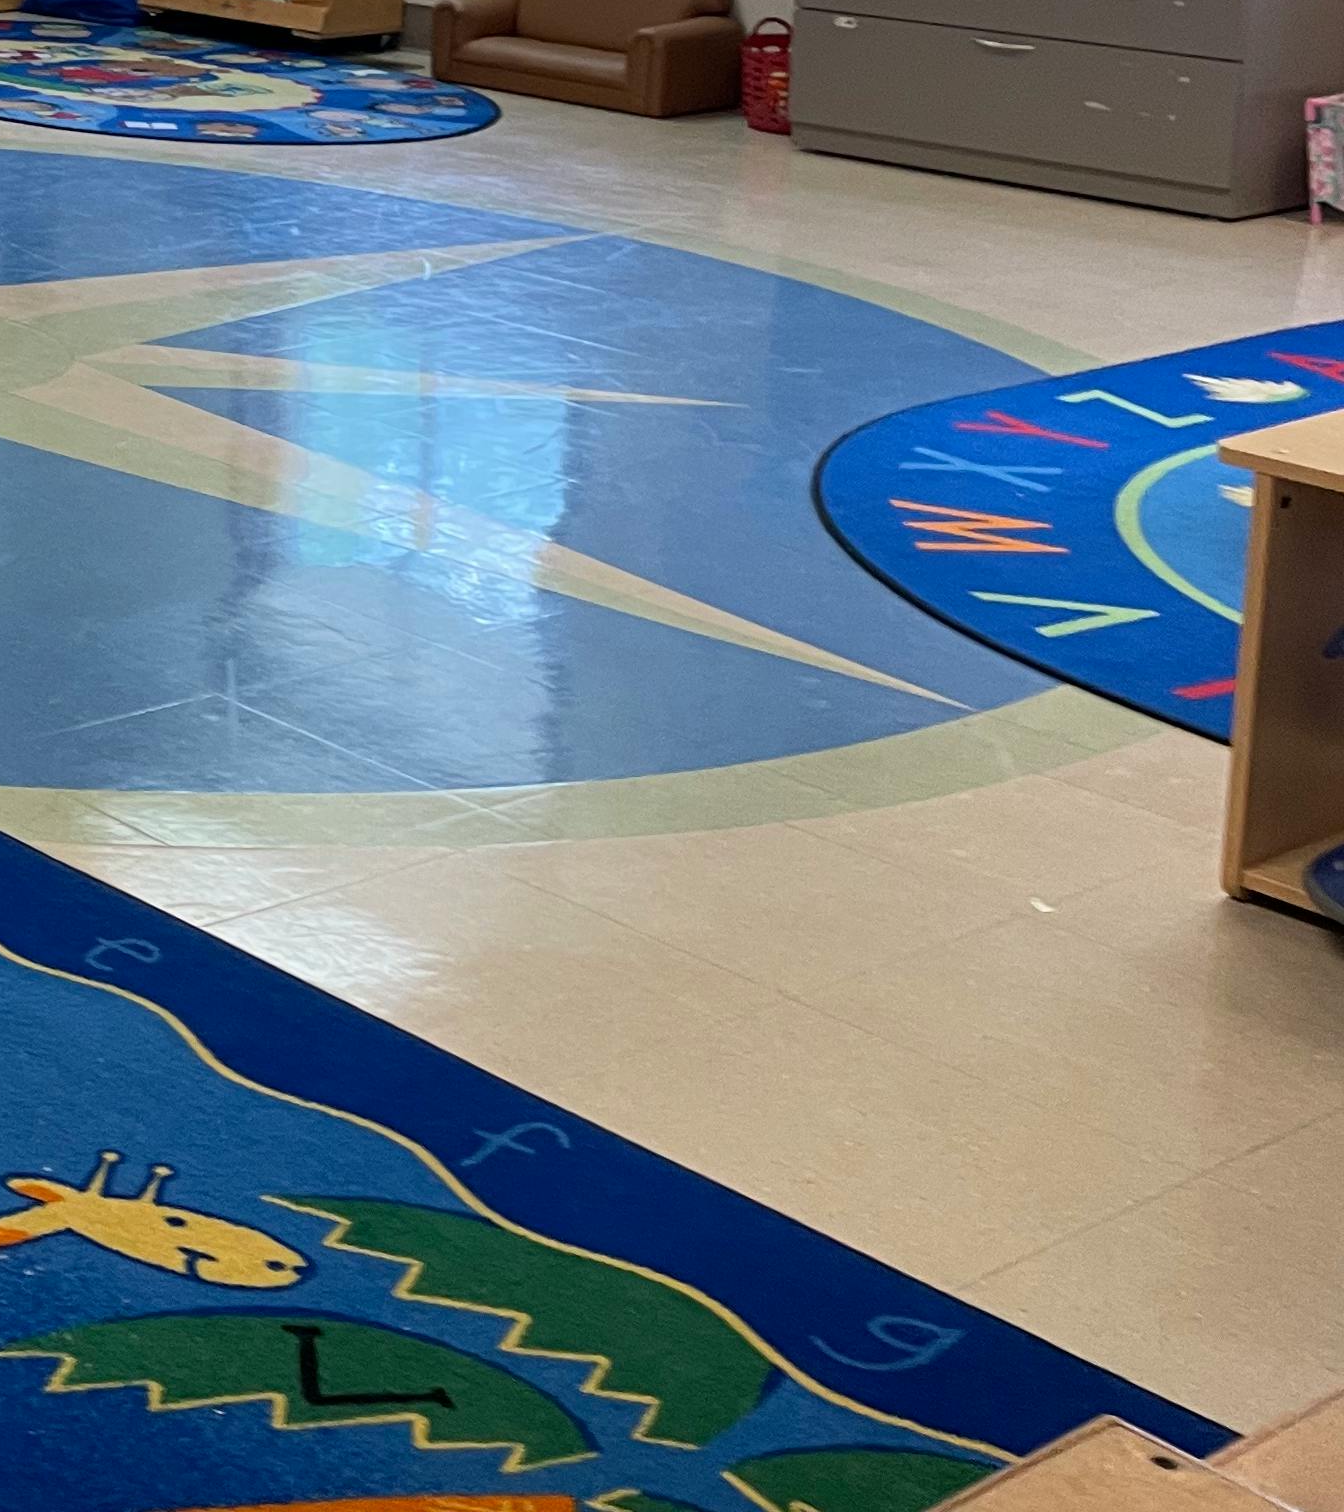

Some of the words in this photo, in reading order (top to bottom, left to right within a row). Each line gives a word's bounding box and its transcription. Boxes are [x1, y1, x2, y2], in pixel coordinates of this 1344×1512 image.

[952, 410, 1109, 450] Y
[1055, 390, 1215, 428] Z
[899, 447, 1063, 493] X
[888, 499, 1070, 554] W
